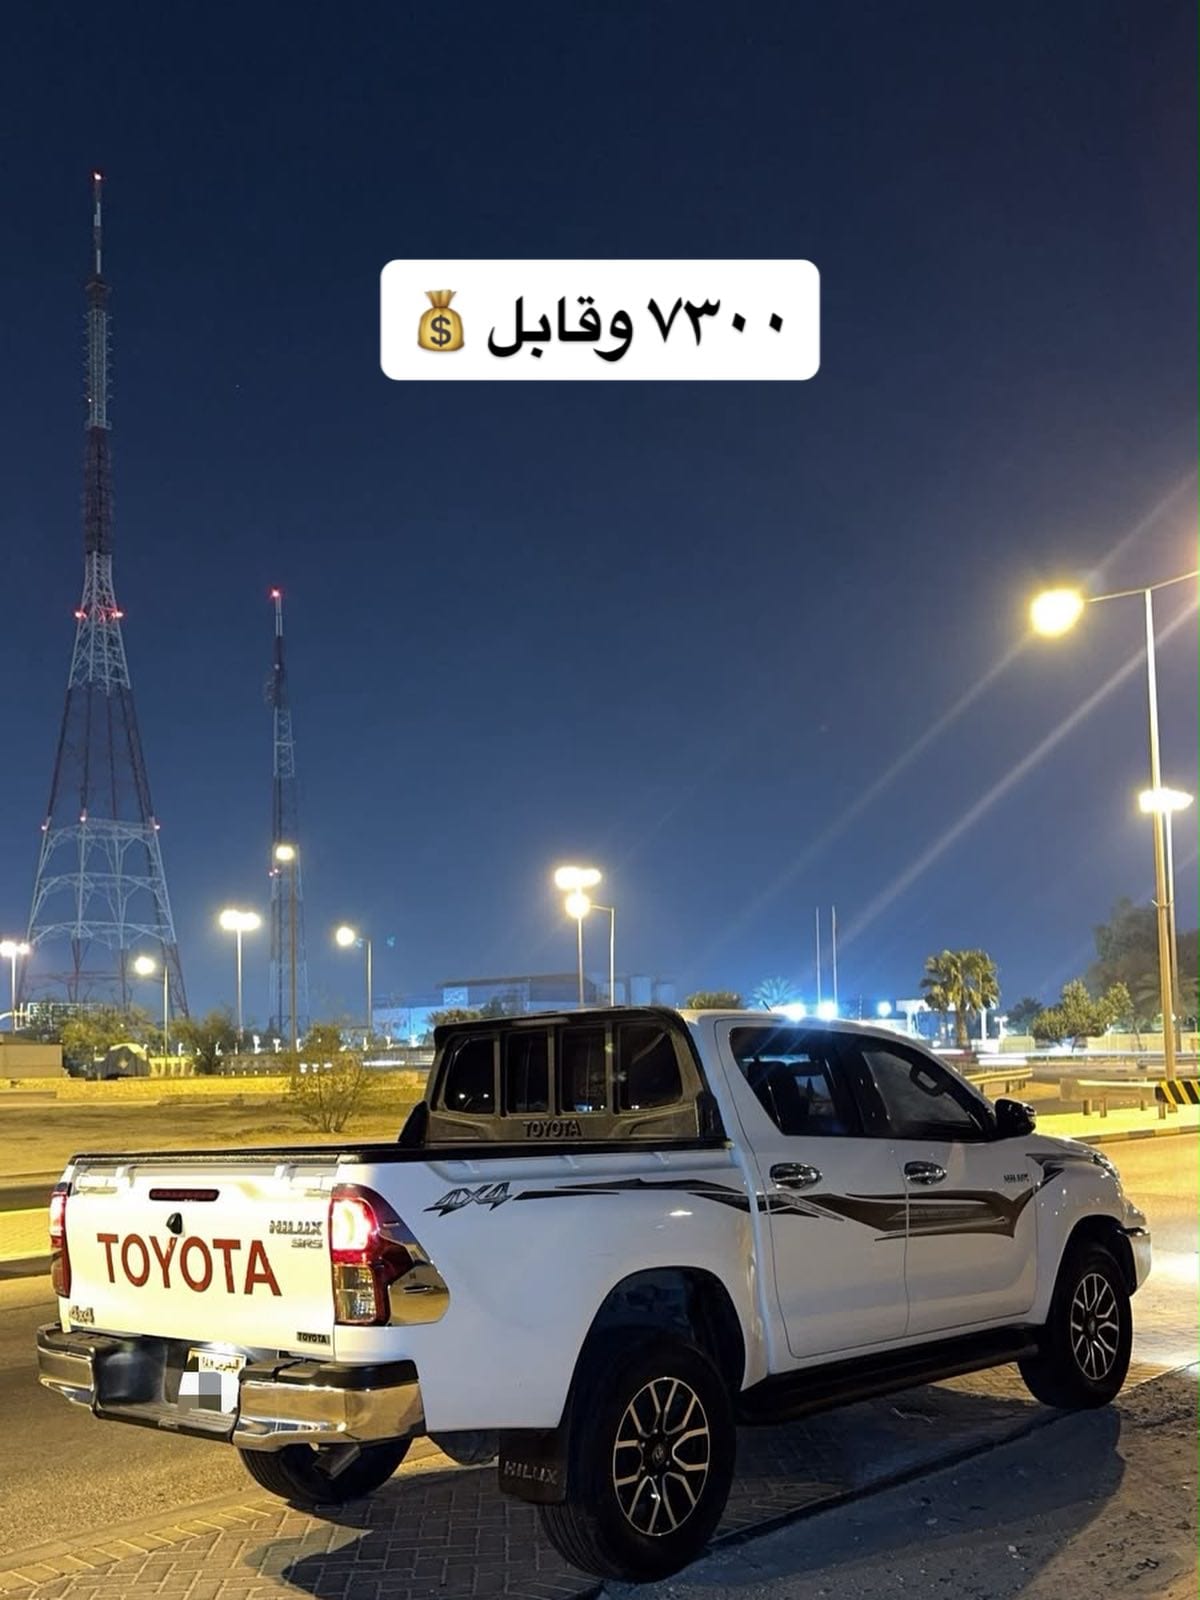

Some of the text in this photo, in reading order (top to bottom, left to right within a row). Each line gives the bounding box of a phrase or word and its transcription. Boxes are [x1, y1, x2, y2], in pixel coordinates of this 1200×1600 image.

[522, 1119, 583, 1139] TOYOTA
[269, 1219, 323, 1236] HILUX
[97, 1232, 283, 1297] TOYOTA
[297, 1331, 329, 1345] TOYOTA
[504, 1460, 558, 1486] HILUX
